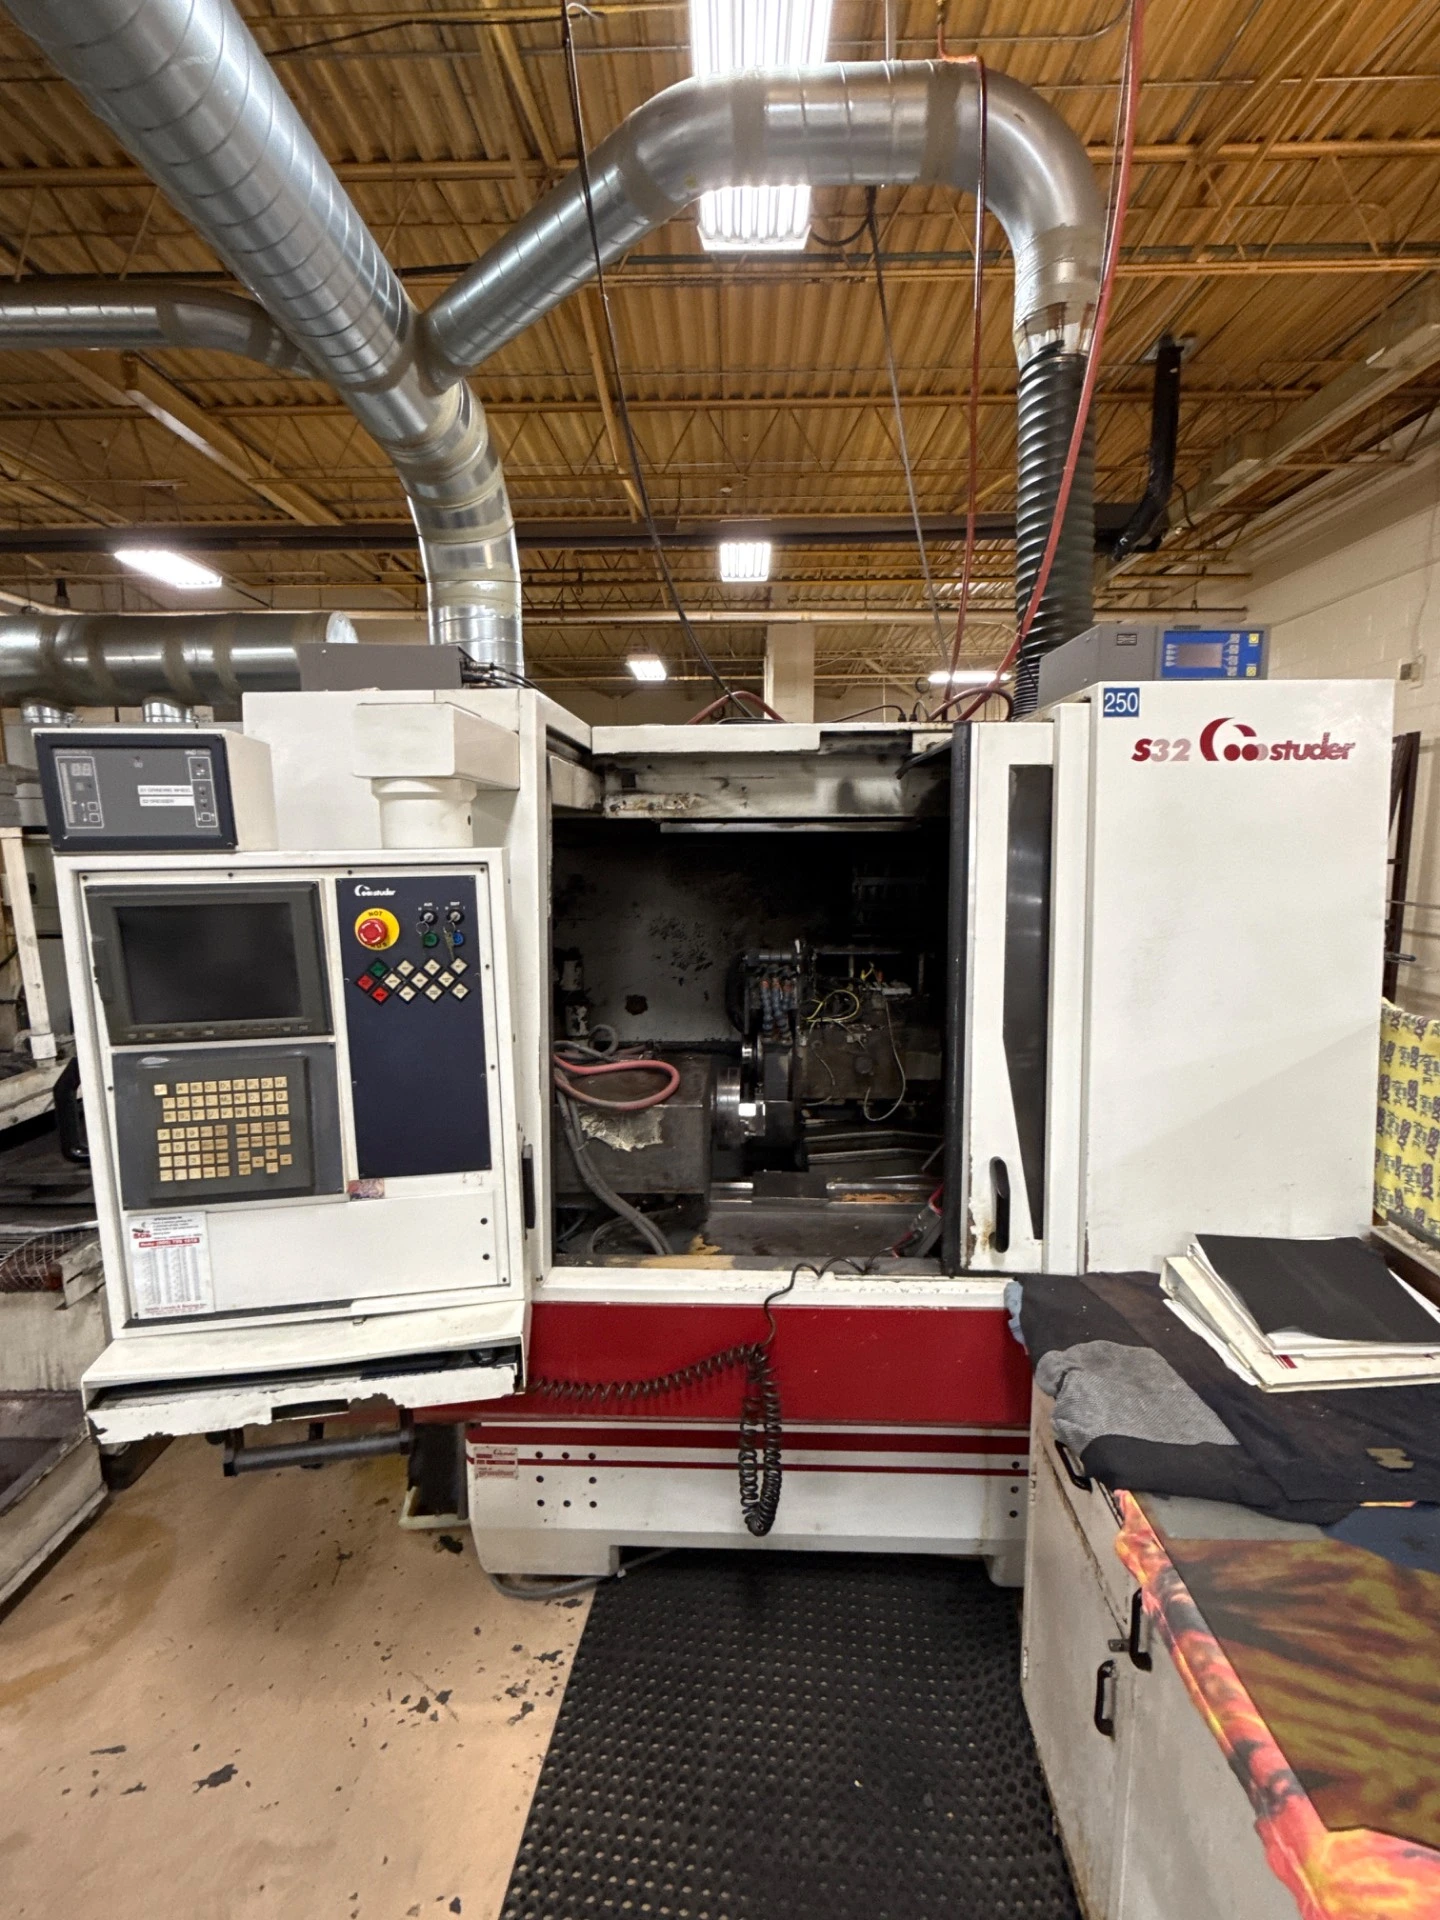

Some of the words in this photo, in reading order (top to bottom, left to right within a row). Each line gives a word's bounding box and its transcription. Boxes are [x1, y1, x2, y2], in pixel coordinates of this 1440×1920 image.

[1104, 692, 1139, 712] 250
[1131, 738, 1191, 762] S32
[1269, 732, 1356, 761] studer
[1421, 1163, 1433, 1202] SEXY
